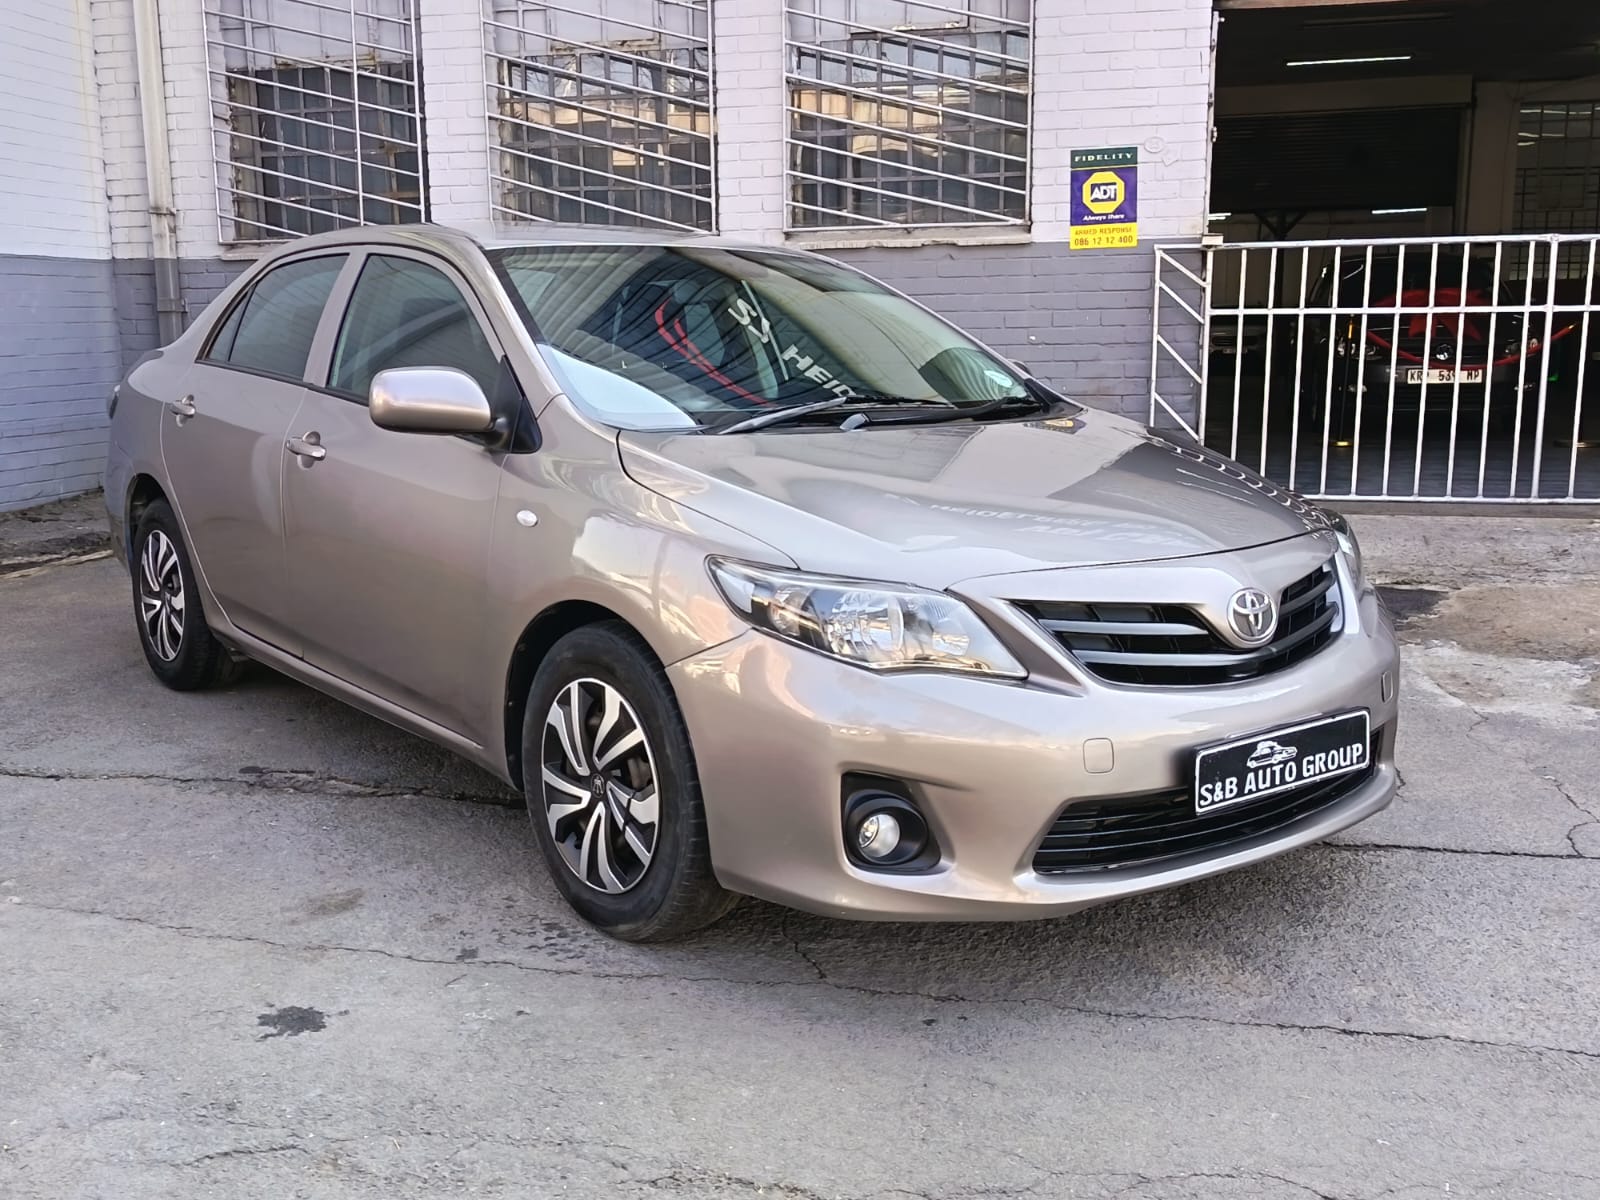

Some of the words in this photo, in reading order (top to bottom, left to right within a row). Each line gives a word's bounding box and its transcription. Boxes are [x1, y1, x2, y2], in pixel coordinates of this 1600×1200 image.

[1074, 152, 1133, 162] FIDELITY
[1090, 184, 1117, 200] ADT
[1099, 227, 1132, 235] RESPONSE
[1074, 238, 1089, 246] 086
[1092, 237, 1102, 245] 12
[1106, 236, 1115, 244] 12
[1410, 370, 1430, 381] KR
[1467, 370, 1480, 380] MP
[1200, 777, 1238, 806] S&B
[1244, 761, 1297, 794] AUTO
[1302, 743, 1363, 777] GROUP
